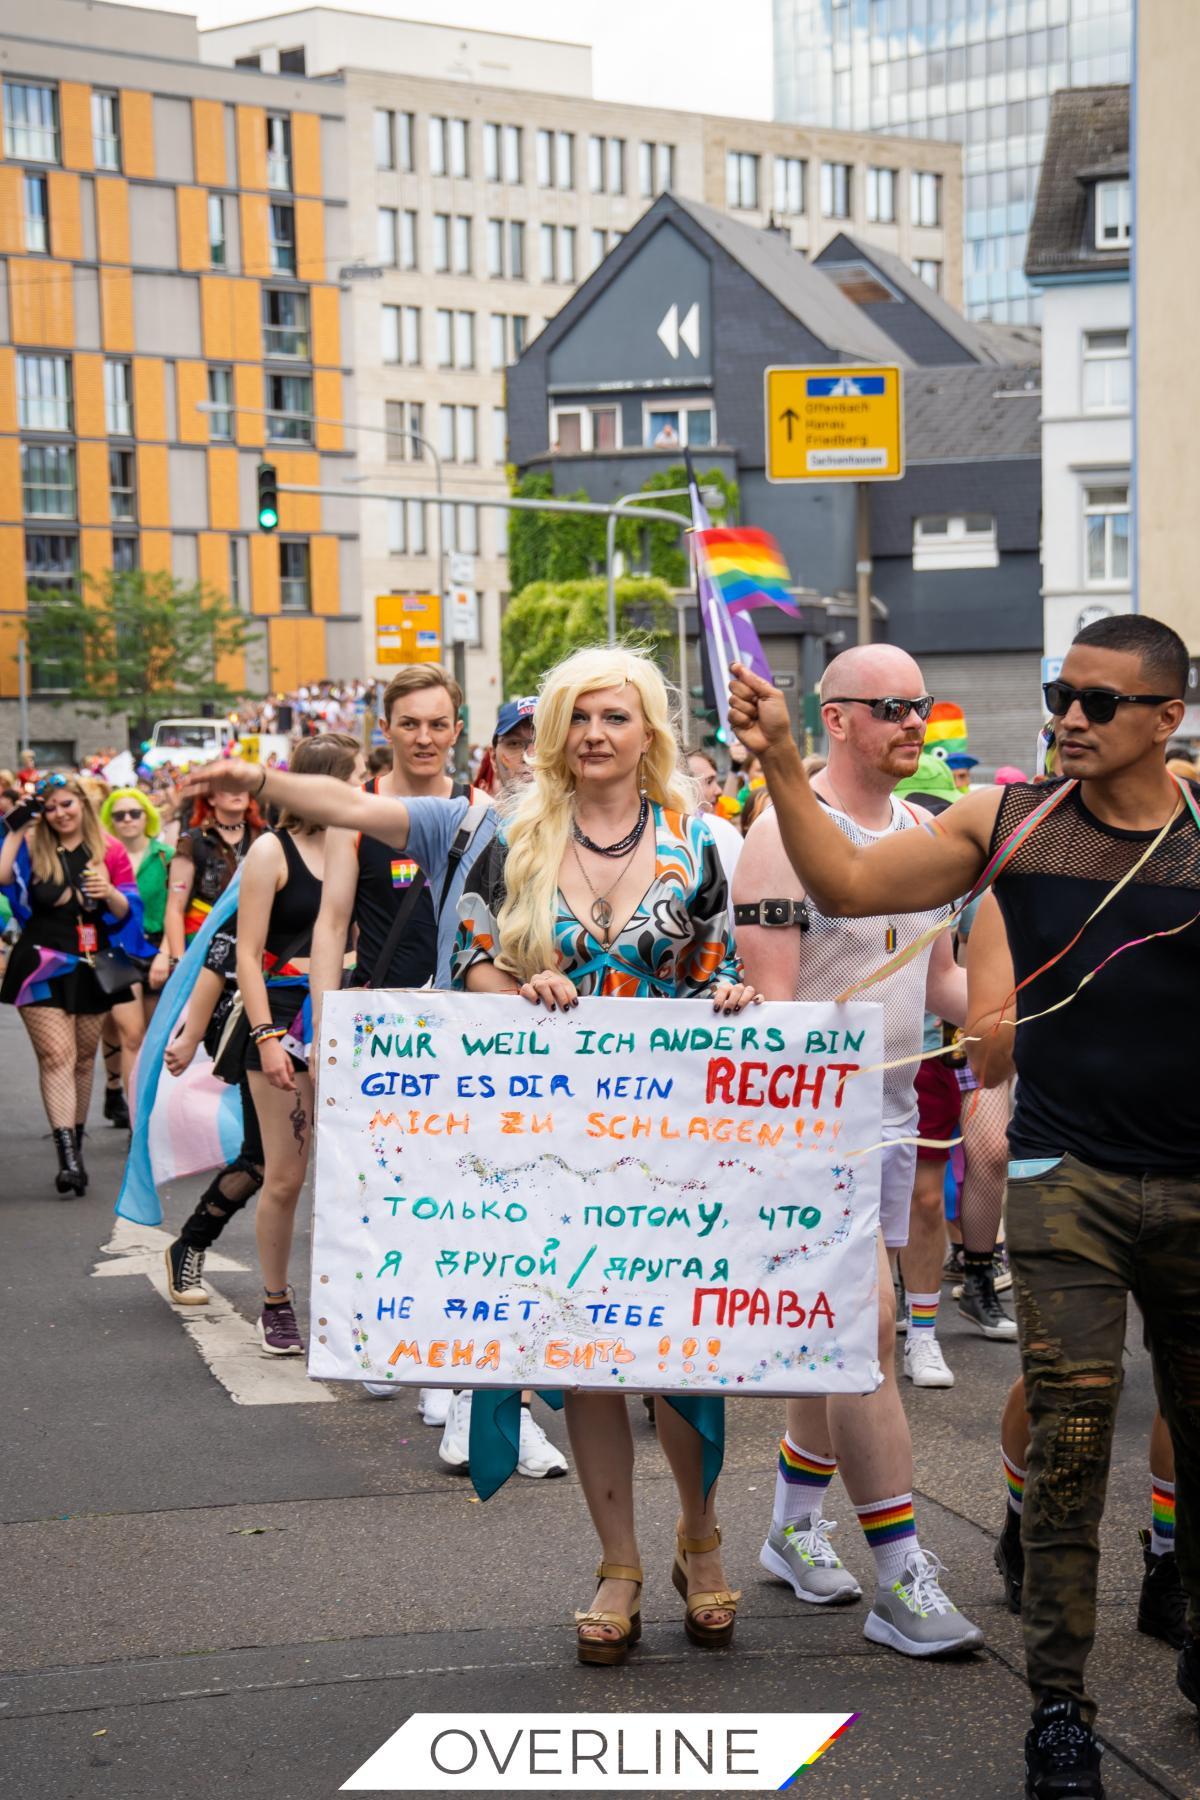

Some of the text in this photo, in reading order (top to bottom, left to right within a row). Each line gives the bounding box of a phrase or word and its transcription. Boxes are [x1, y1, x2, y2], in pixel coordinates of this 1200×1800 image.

[371, 1026, 865, 1058] NUR WEIL ICH ANDERS BIN
[361, 1056, 860, 1109] GIBT ES DIR KEIN RECHT
[369, 1109, 470, 1135] MICH
[500, 1111, 554, 1135] ZU
[384, 1196, 822, 1237] ТОЛЬКО ПОТОМУ, ЧТО
[376, 1250, 403, 1278] Я
[377, 1287, 836, 1329] НЕ ДАЁТ ТЕБЕ ПРАВА
[387, 1339, 501, 1370] МЕНЯ
[544, 1337, 636, 1370] БИТЬ
